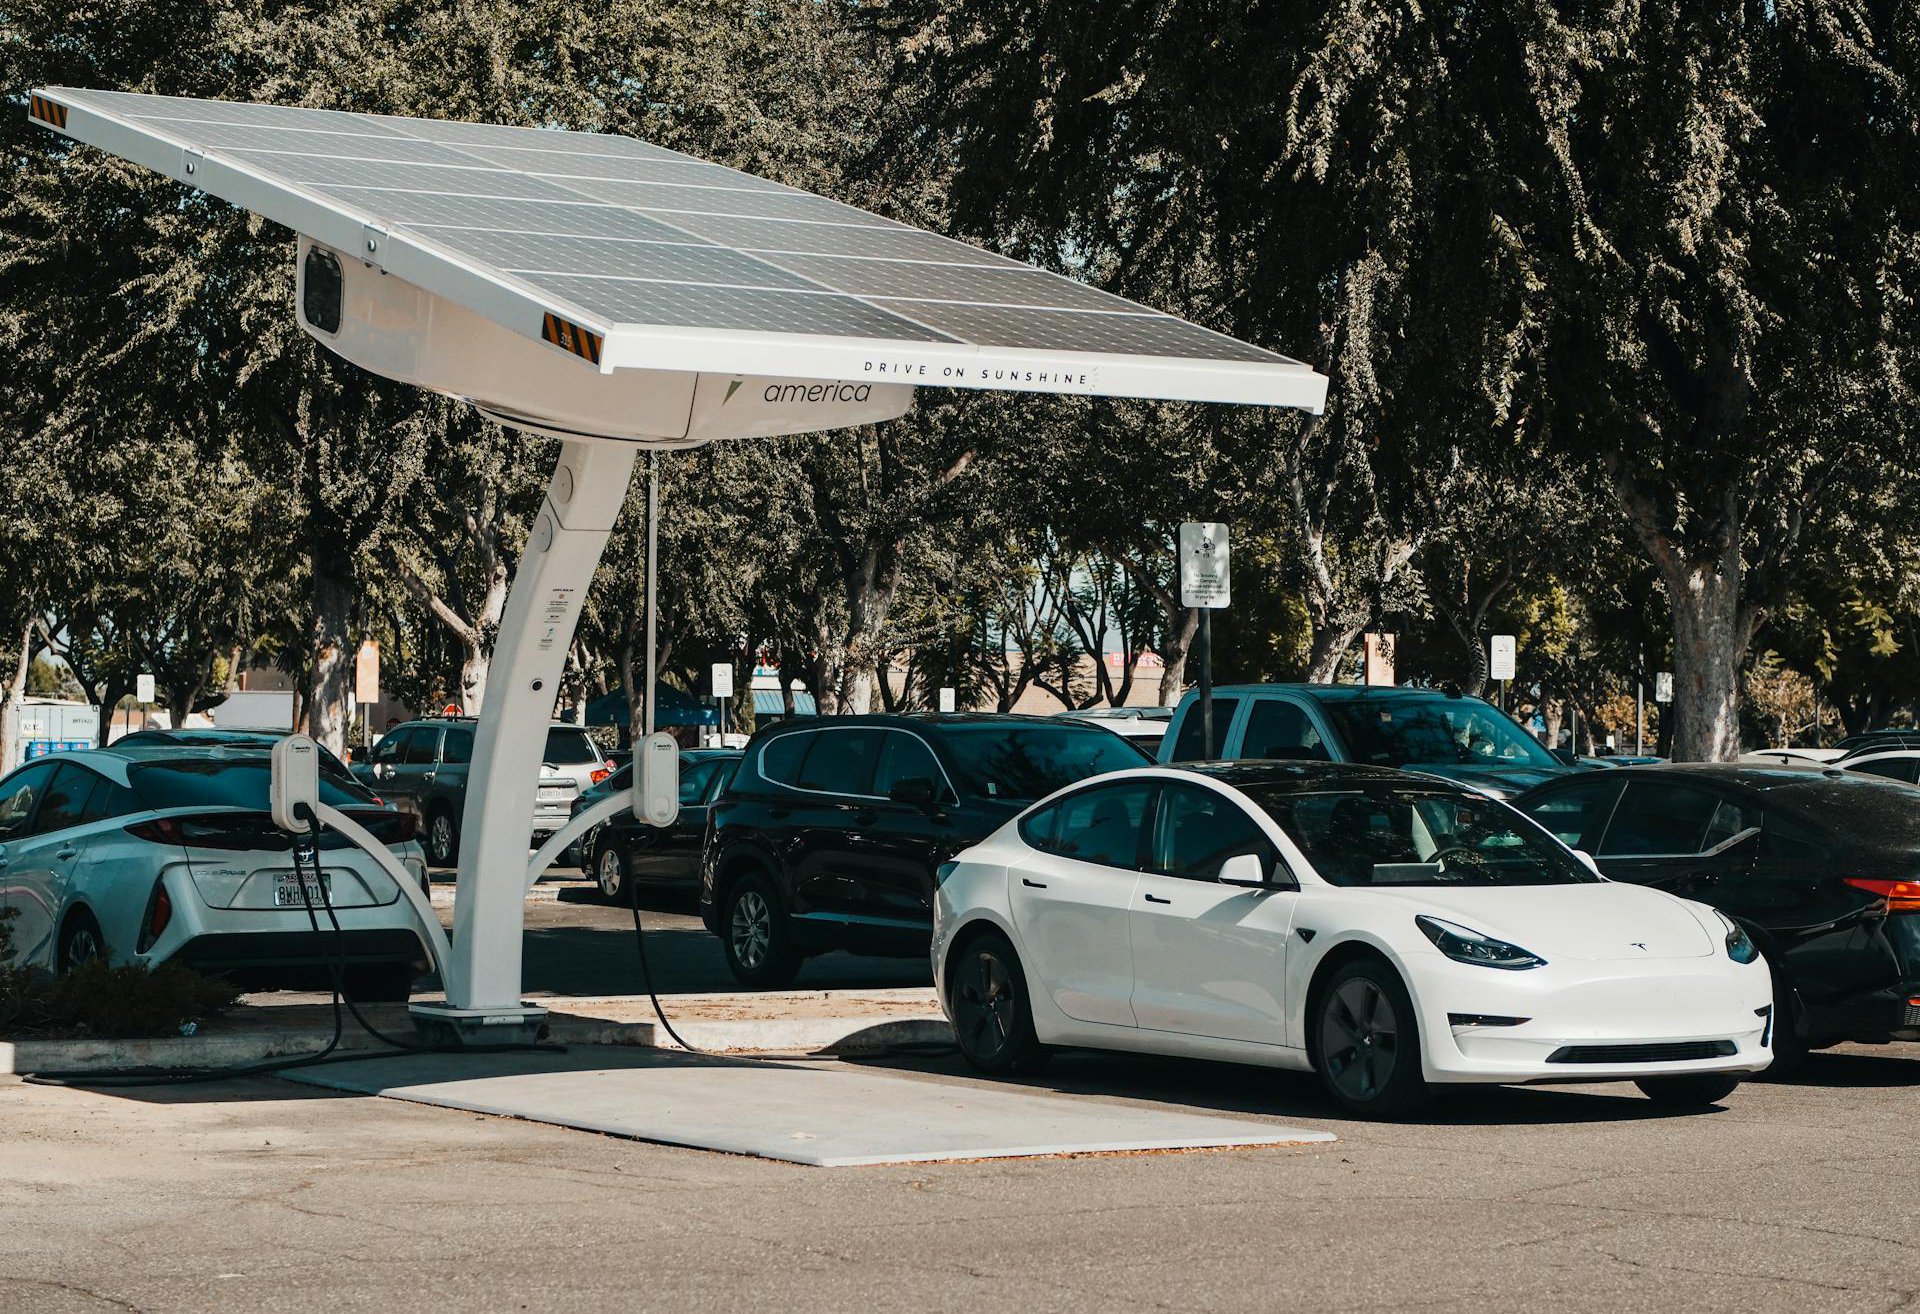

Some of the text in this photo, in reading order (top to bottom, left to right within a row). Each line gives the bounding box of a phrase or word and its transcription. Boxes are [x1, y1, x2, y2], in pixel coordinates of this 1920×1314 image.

[864, 361, 1086, 384] DRIVE ON SUNSHINE
[764, 380, 872, 402] america
[279, 885, 326, 900] 8WH01
